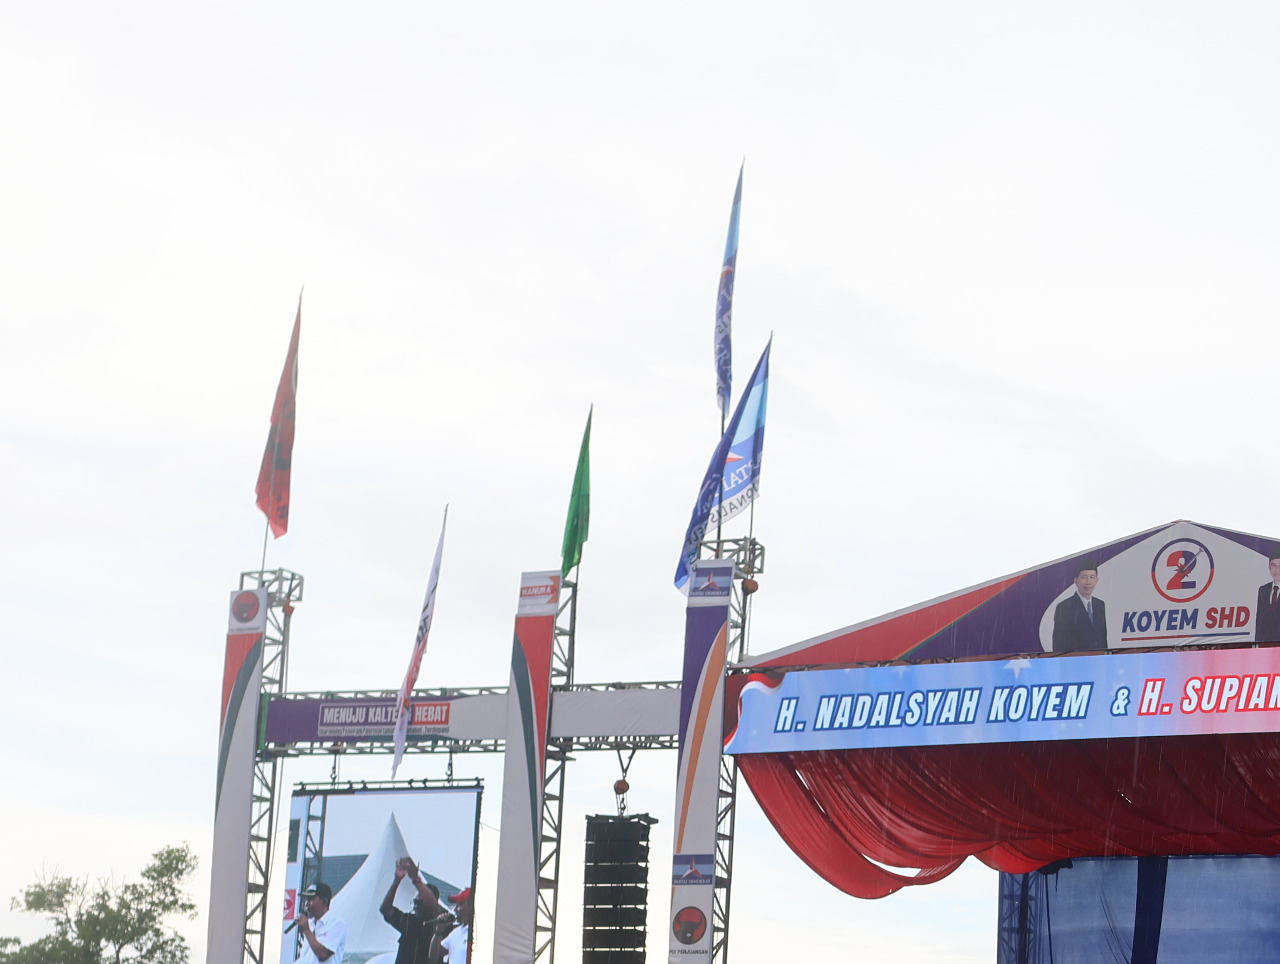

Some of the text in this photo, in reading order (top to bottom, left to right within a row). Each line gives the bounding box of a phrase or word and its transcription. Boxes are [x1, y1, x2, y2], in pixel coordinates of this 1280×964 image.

[1166, 550, 1197, 590] 2
[1121, 606, 1250, 633] KOYEM SHD
[323, 704, 448, 724] MENUJU KALTE HEBAT
[774, 697, 806, 734] H.
[813, 687, 982, 731] NADALSYAH
[986, 682, 1094, 723] KOYEM
[1111, 687, 1131, 716] &
[1138, 678, 1173, 716] H.
